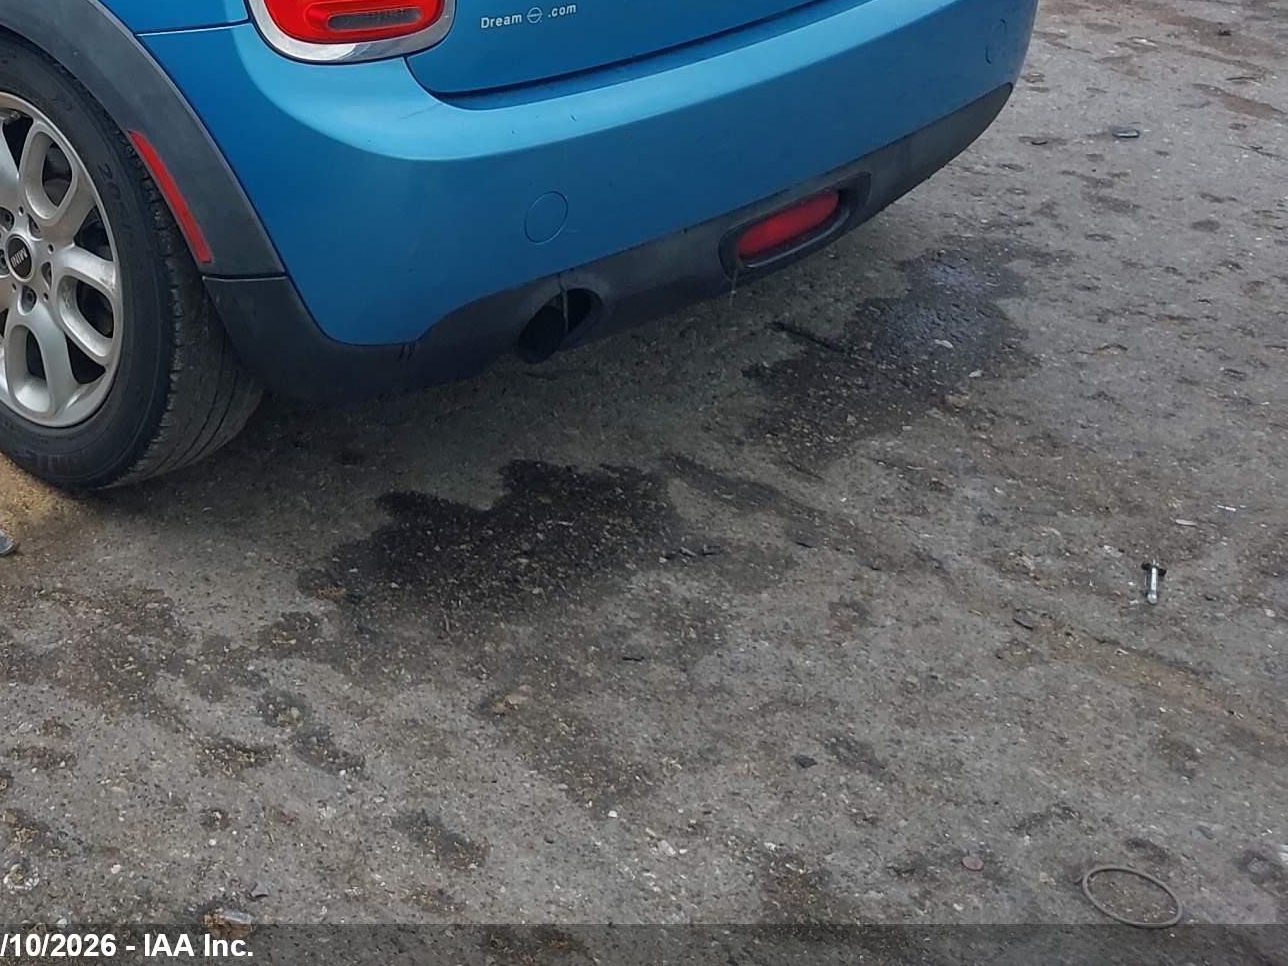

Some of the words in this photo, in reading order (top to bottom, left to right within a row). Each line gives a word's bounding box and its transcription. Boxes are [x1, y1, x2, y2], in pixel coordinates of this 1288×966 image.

[480, 13, 522, 29] Dream
[548, 4, 577, 18] .com
[10, 245, 28, 268] MINI
